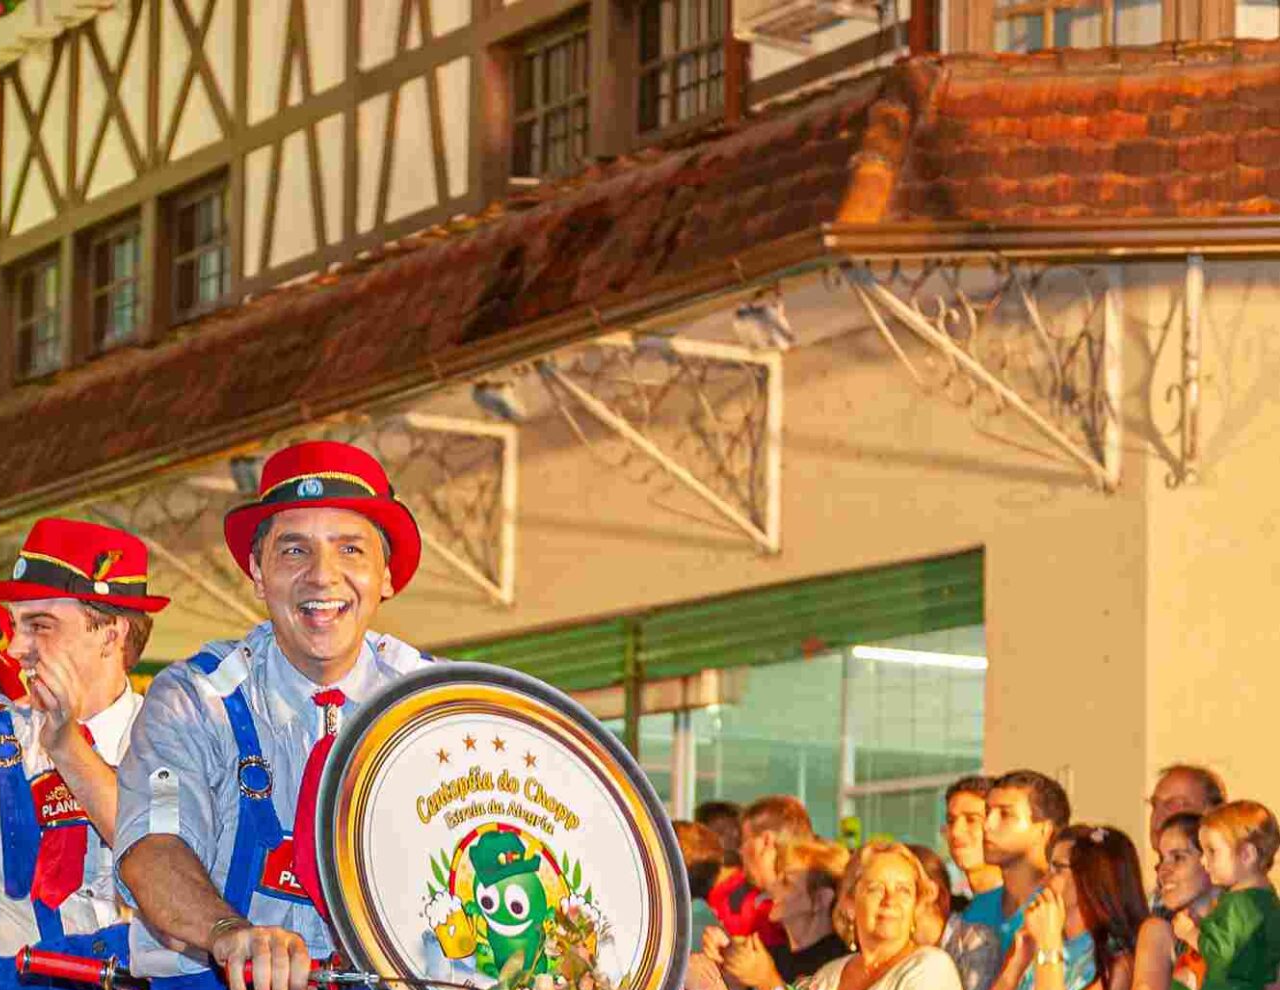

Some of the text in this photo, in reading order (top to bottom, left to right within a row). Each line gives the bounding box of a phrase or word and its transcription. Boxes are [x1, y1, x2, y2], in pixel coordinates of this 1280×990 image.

[417, 766, 580, 831] Centopéia do Chopp
